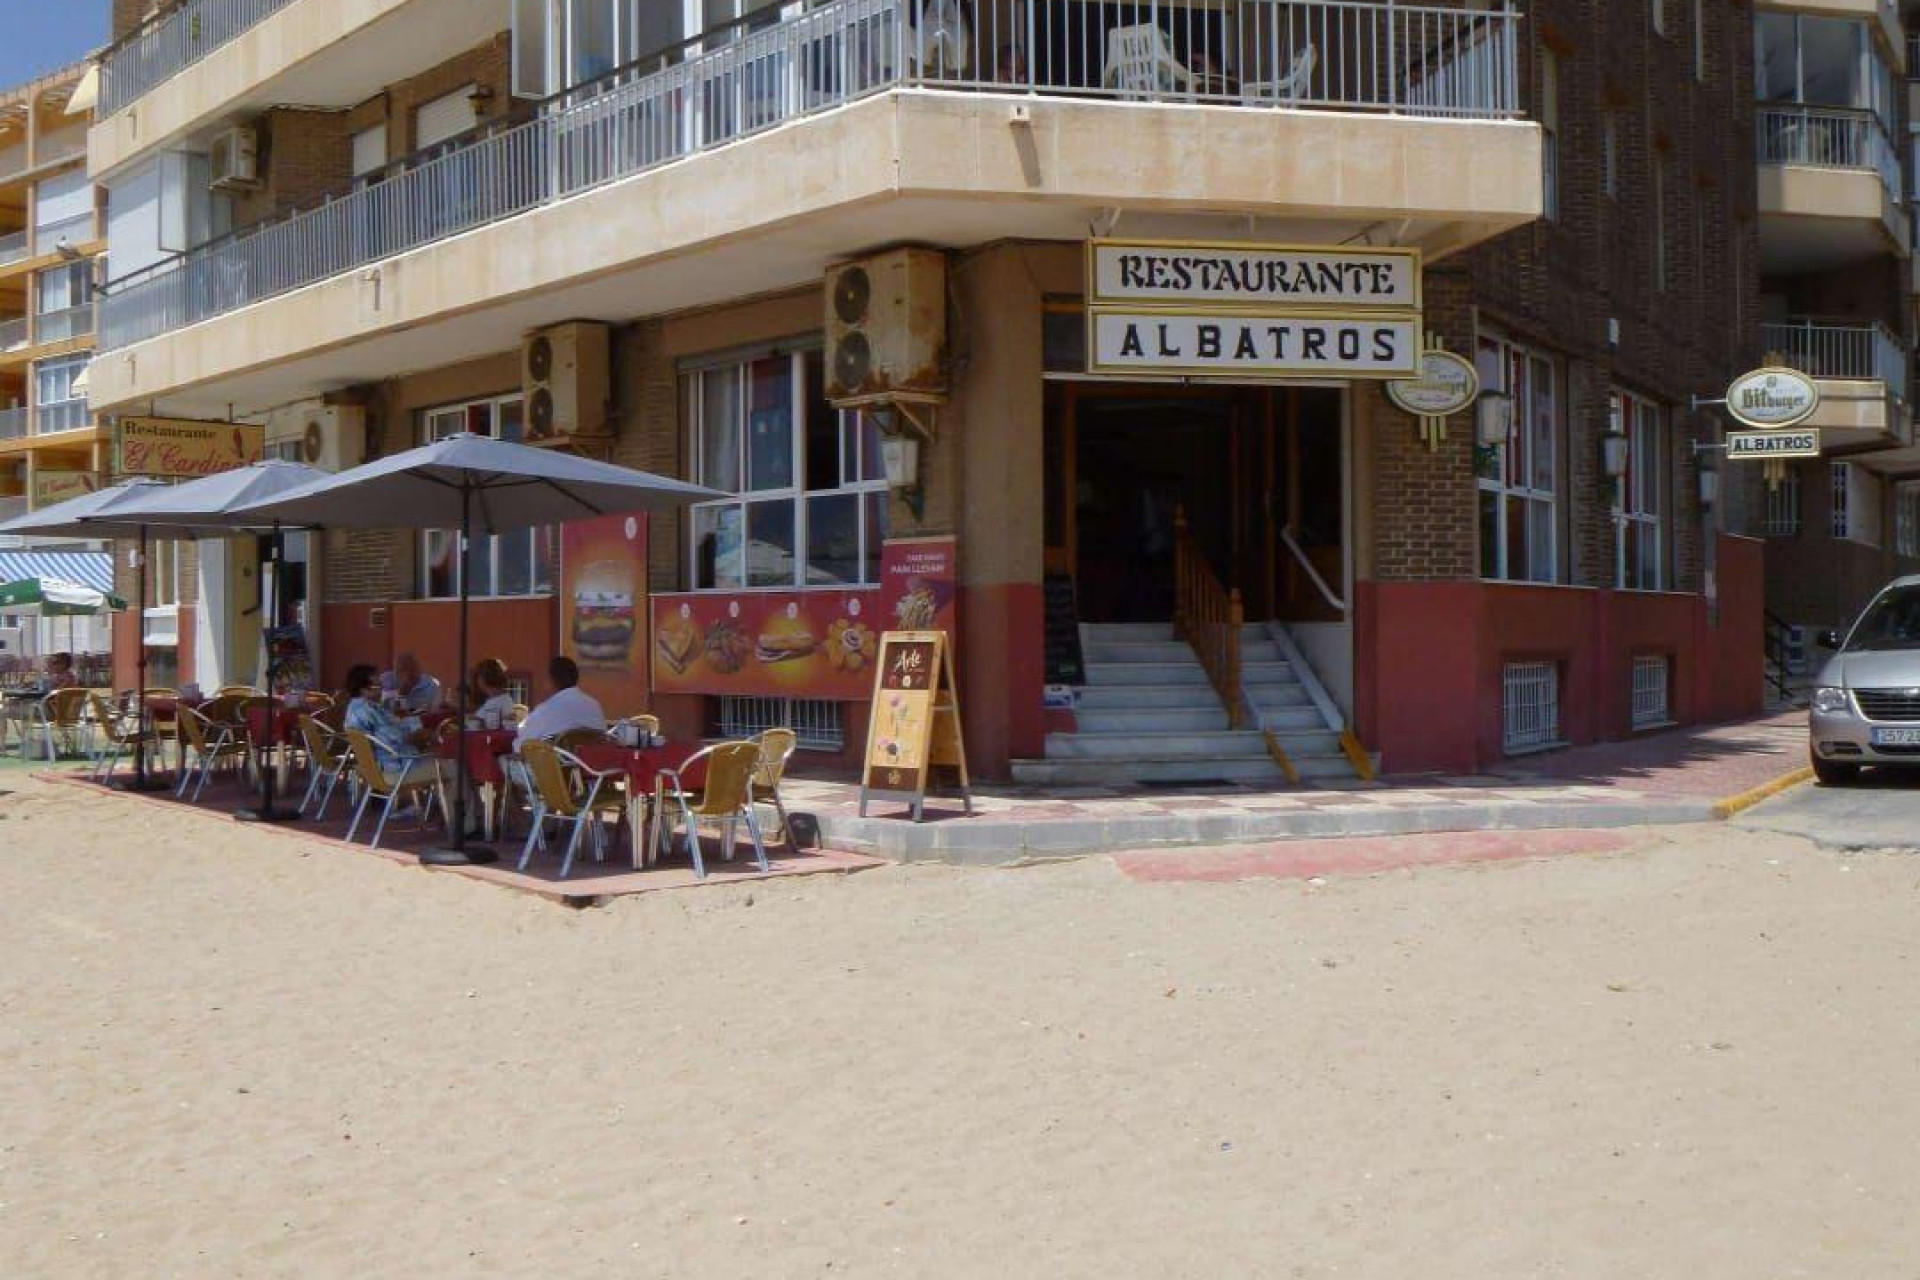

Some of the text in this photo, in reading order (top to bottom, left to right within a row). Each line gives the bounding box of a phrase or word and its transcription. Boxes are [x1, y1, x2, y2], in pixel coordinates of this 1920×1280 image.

[1118, 255, 1395, 295] RESTAURANTE
[1119, 323, 1396, 361] ALBATROS
[1742, 387, 1805, 410] Bitburger
[125, 420, 218, 439] Restaurante
[1734, 435, 1814, 452] ALBATROS
